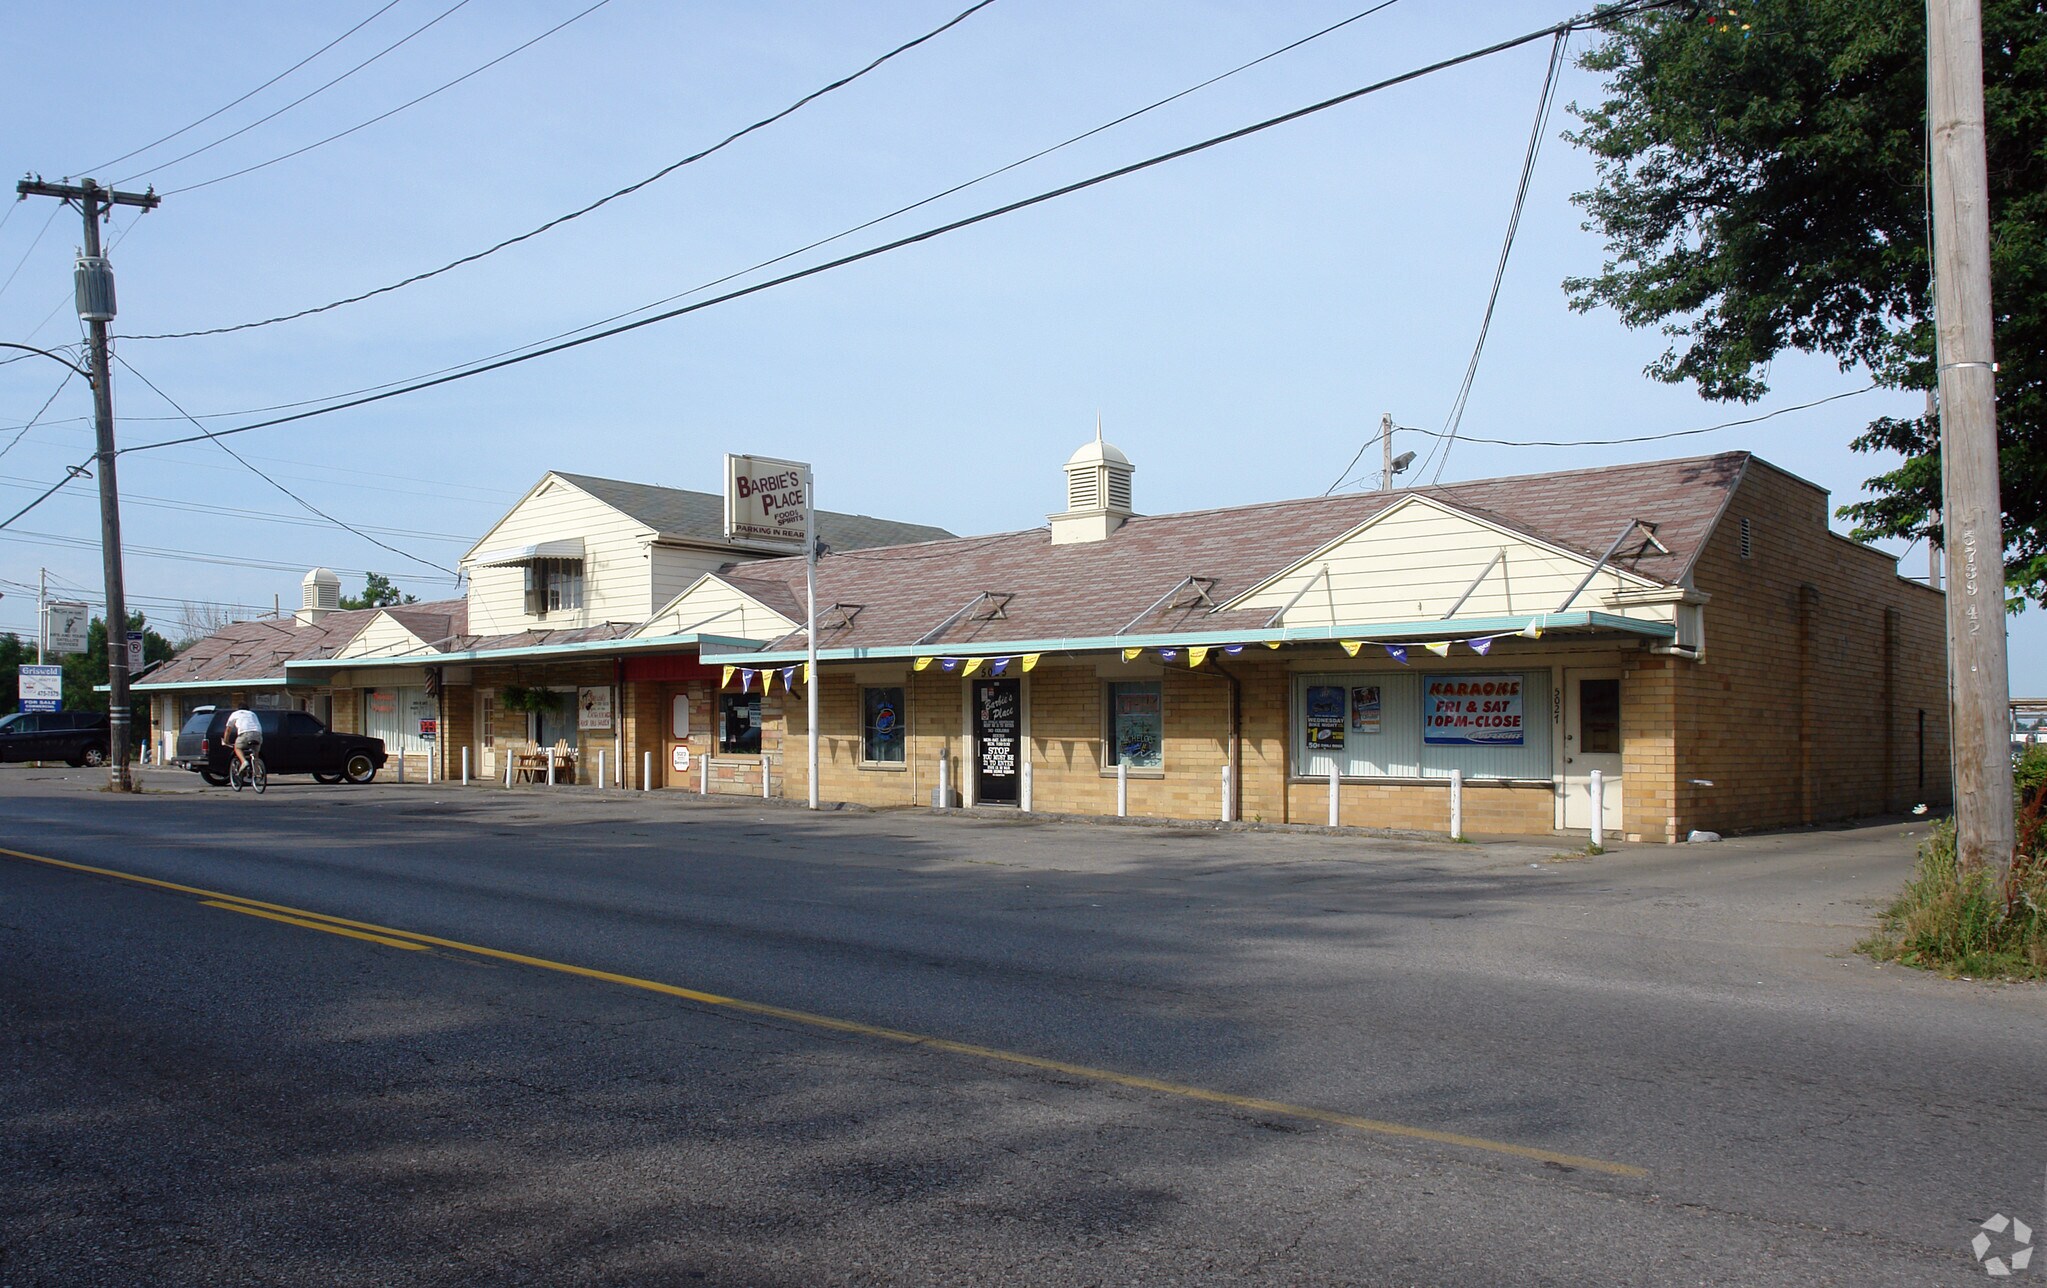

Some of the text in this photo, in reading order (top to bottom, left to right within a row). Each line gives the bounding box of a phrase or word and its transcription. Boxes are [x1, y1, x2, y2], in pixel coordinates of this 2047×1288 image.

[736, 471, 799, 498] BARBIE'S
[761, 490, 804, 516] PLACE
[774, 510, 795, 520] FOOD
[777, 514, 804, 526] SPIRITS
[736, 525, 771, 535] PARKING
[782, 530, 805, 538] REAR
[1429, 682, 1520, 696] KARAOKE
[985, 692, 1013, 710] Barbie's
[1436, 701, 1510, 712] FRI & SAT
[993, 707, 1014, 720] Place
[1427, 715, 1521, 727] 10PM-CLOSE
